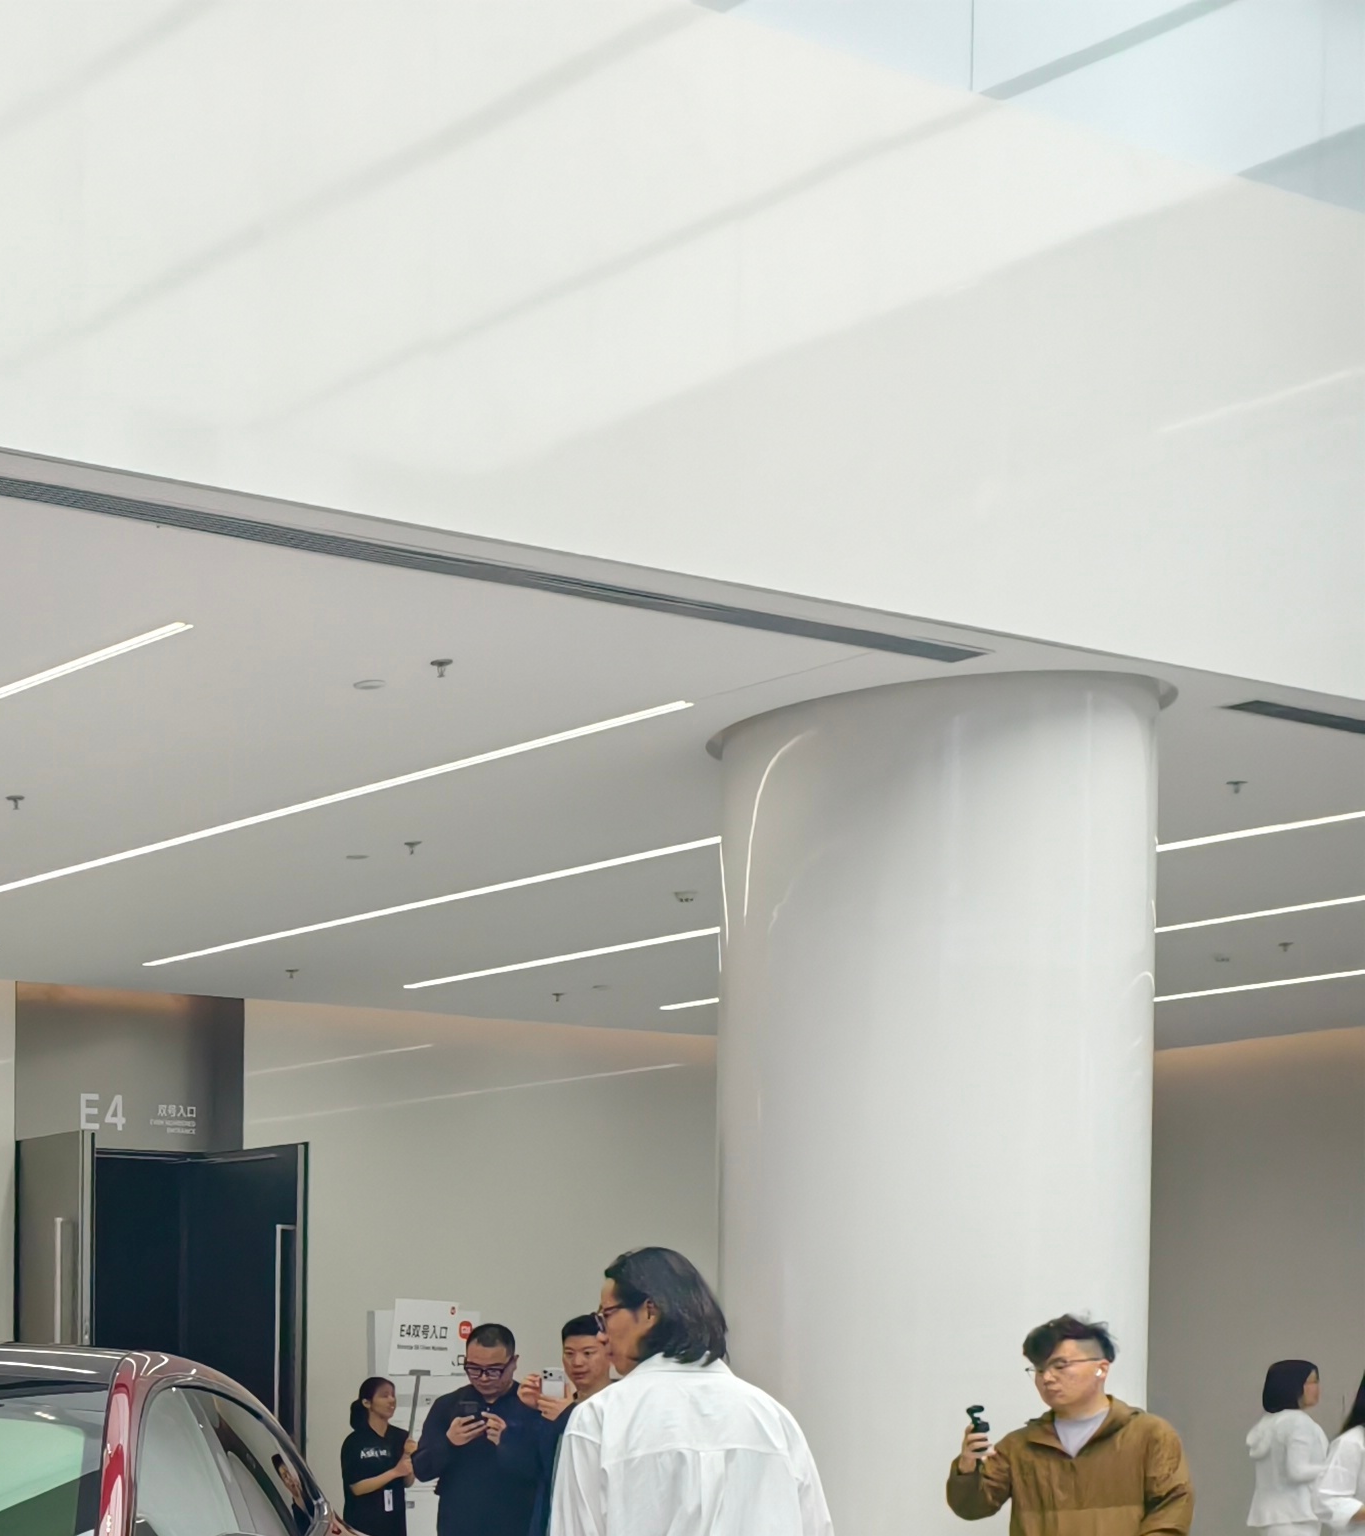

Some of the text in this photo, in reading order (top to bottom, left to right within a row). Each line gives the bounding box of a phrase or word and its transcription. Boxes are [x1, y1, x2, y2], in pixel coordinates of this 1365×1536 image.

[80, 1092, 127, 1131] E4
[157, 1104, 197, 1118] 双号入口
[399, 1324, 448, 1339] E4双号入口
